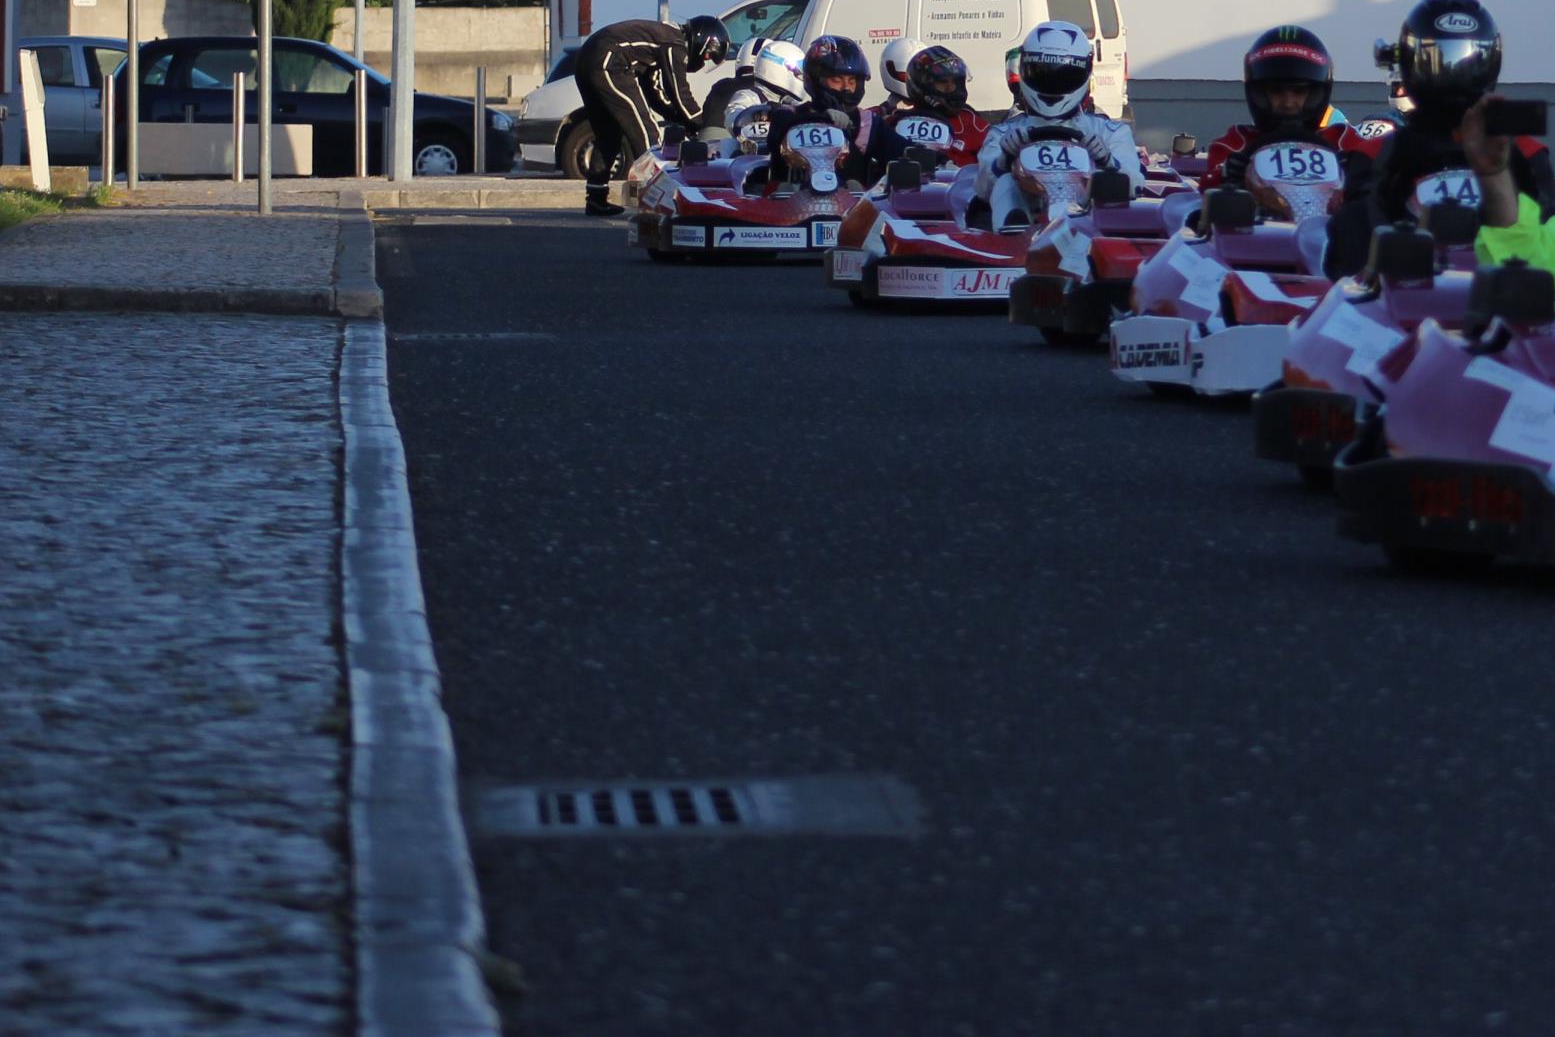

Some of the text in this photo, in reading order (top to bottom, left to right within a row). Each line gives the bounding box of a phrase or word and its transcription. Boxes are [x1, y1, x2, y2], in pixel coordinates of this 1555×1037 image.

[1444, 15, 1472, 27] Arai
[750, 124, 768, 135] 15
[795, 128, 832, 147] 161
[907, 121, 942, 141] 160
[1037, 146, 1072, 167] 64
[1270, 148, 1327, 176] 158
[1434, 177, 1479, 205] 14
[740, 230, 801, 240] LIGAÇÃO VELOZ
[953, 269, 1000, 293] AJM
